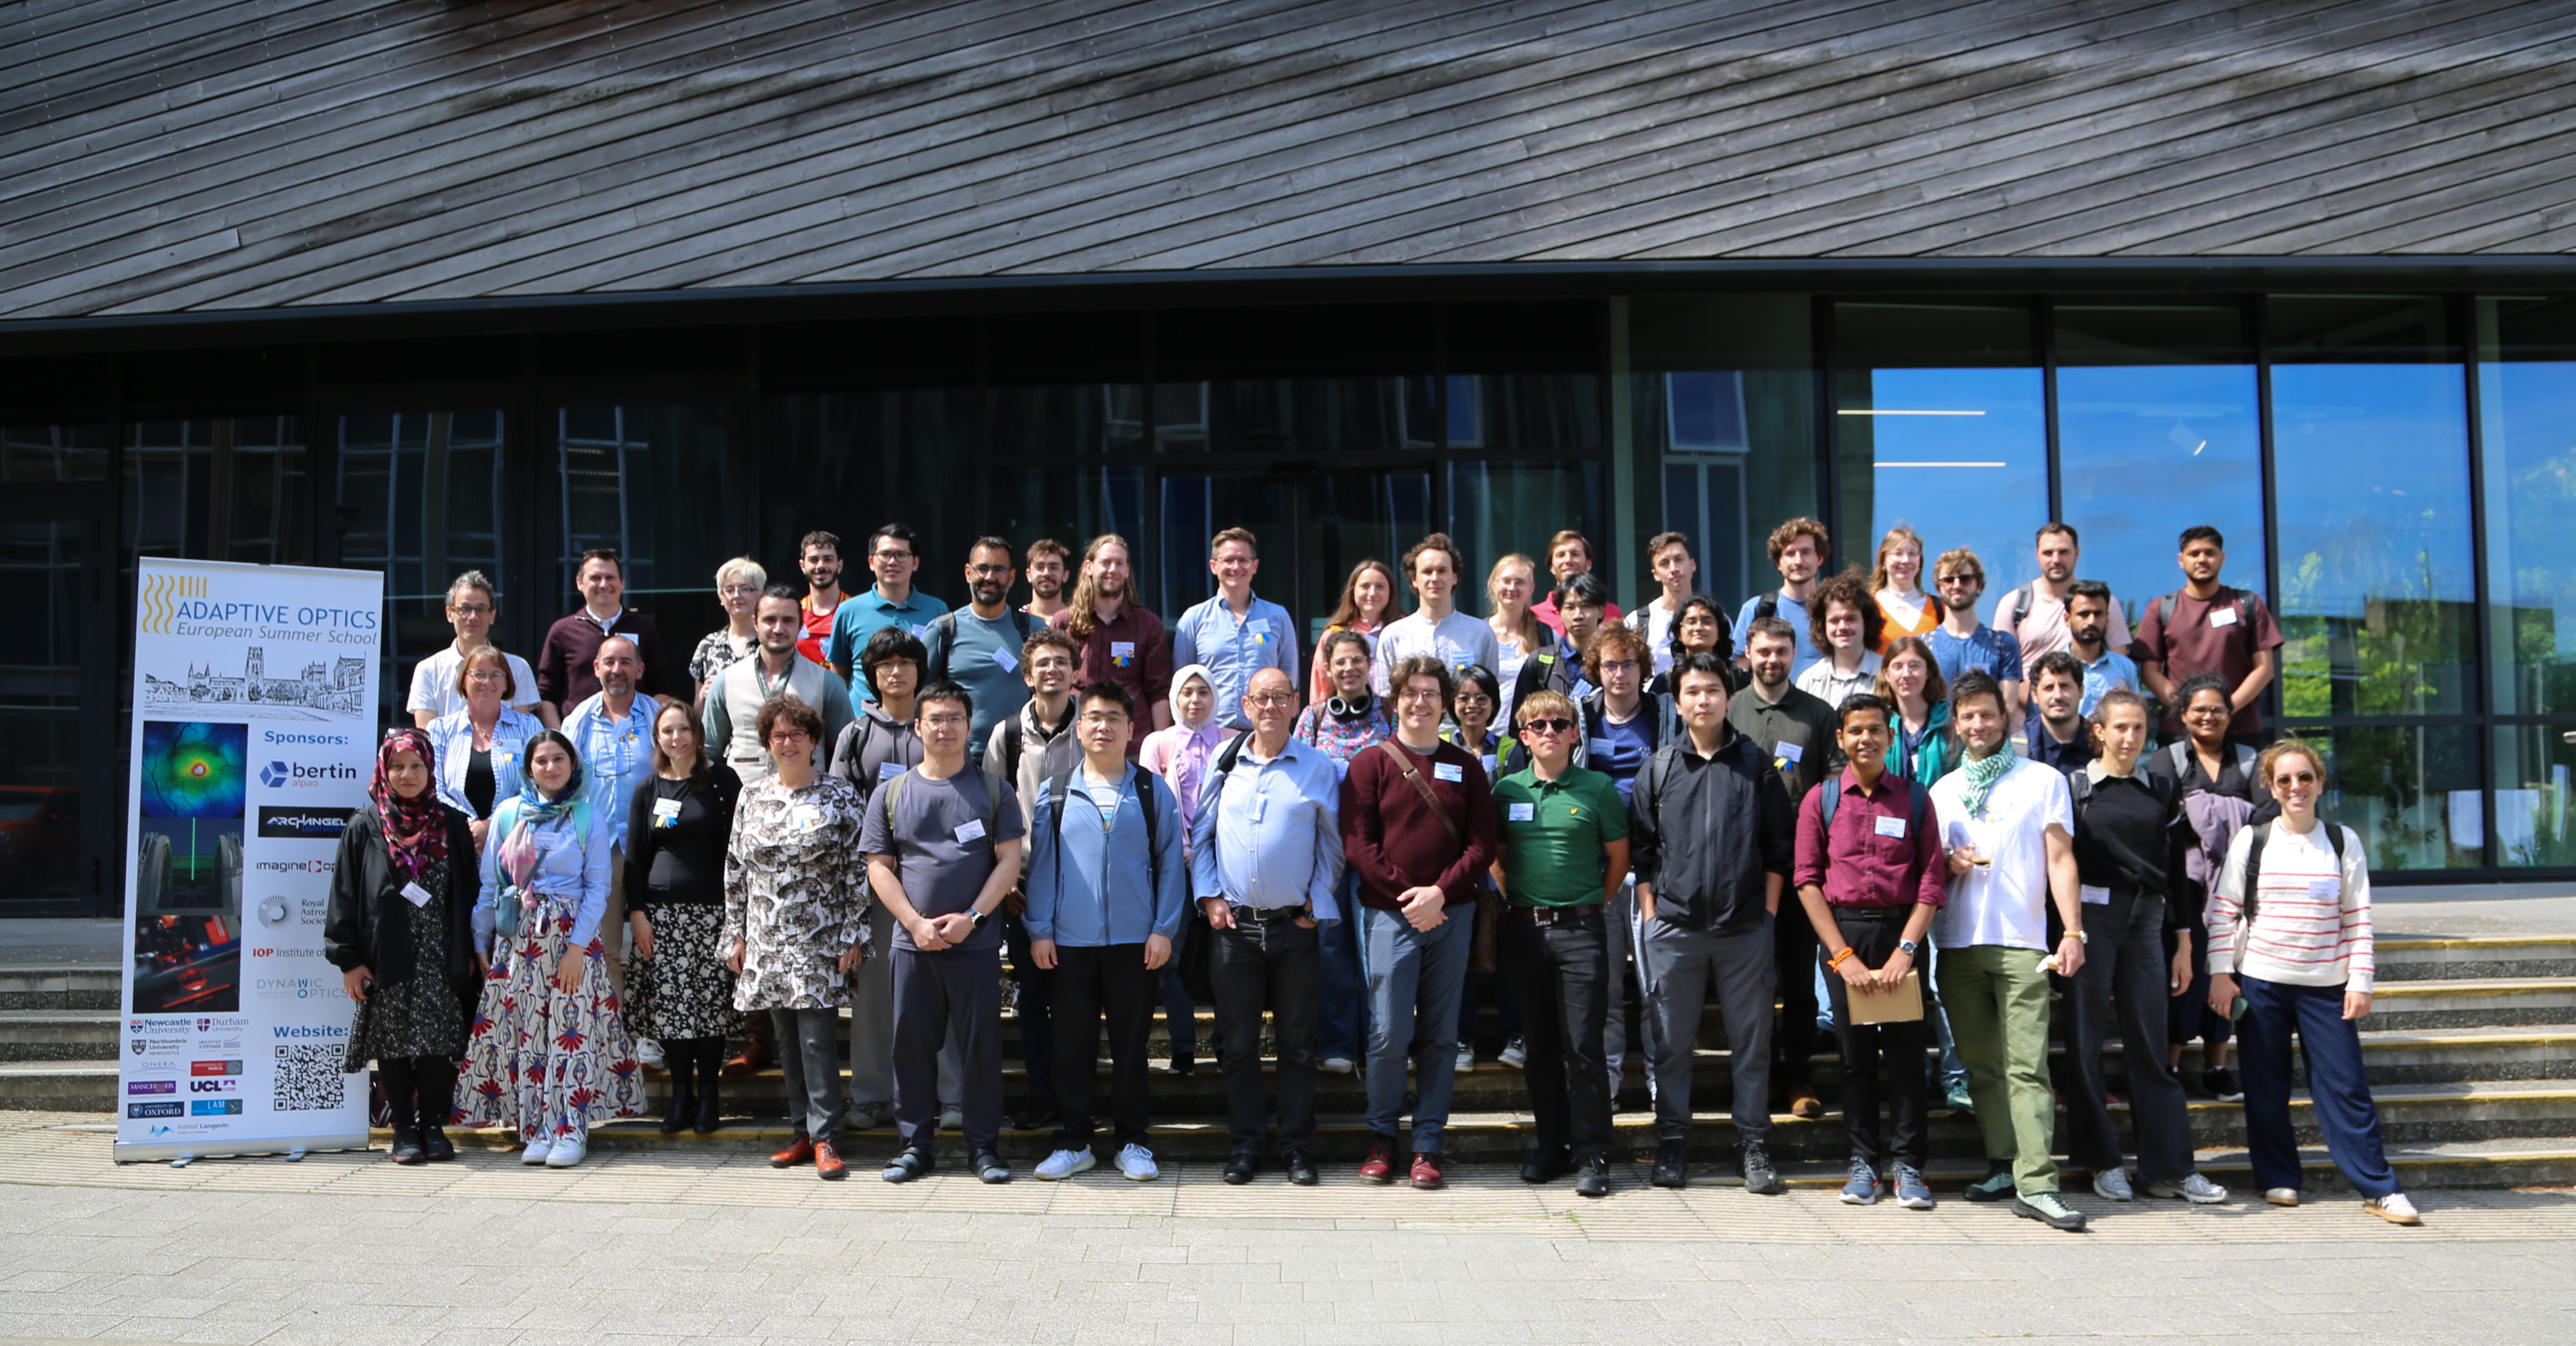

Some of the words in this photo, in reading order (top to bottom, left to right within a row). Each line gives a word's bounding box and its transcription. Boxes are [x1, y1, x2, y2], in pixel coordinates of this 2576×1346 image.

[177, 601, 290, 624] ADAPTIVE
[297, 607, 376, 629] OPTICS
[177, 622, 253, 640] European
[259, 625, 323, 642] Summer
[328, 629, 377, 645] School
[264, 731, 348, 745] Sponsors:
[293, 762, 356, 779] bertin
[292, 779, 318, 788] alpao
[266, 813, 347, 829] ARCHANGEL
[256, 862, 307, 872] imagine
[301, 899, 324, 908] Royal
[301, 917, 326, 925] Societ
[252, 948, 274, 957] IOP
[277, 948, 314, 957] Institute
[316, 948, 326, 957] of
[297, 988, 349, 998] OPTICS
[212, 1017, 249, 1026] Durham
[145, 1026, 191, 1035] University
[273, 1025, 349, 1037] Website:
[190, 1080, 222, 1092] UCL
[208, 1100, 225, 1109] LAM
[145, 1108, 181, 1116] OXFORD
